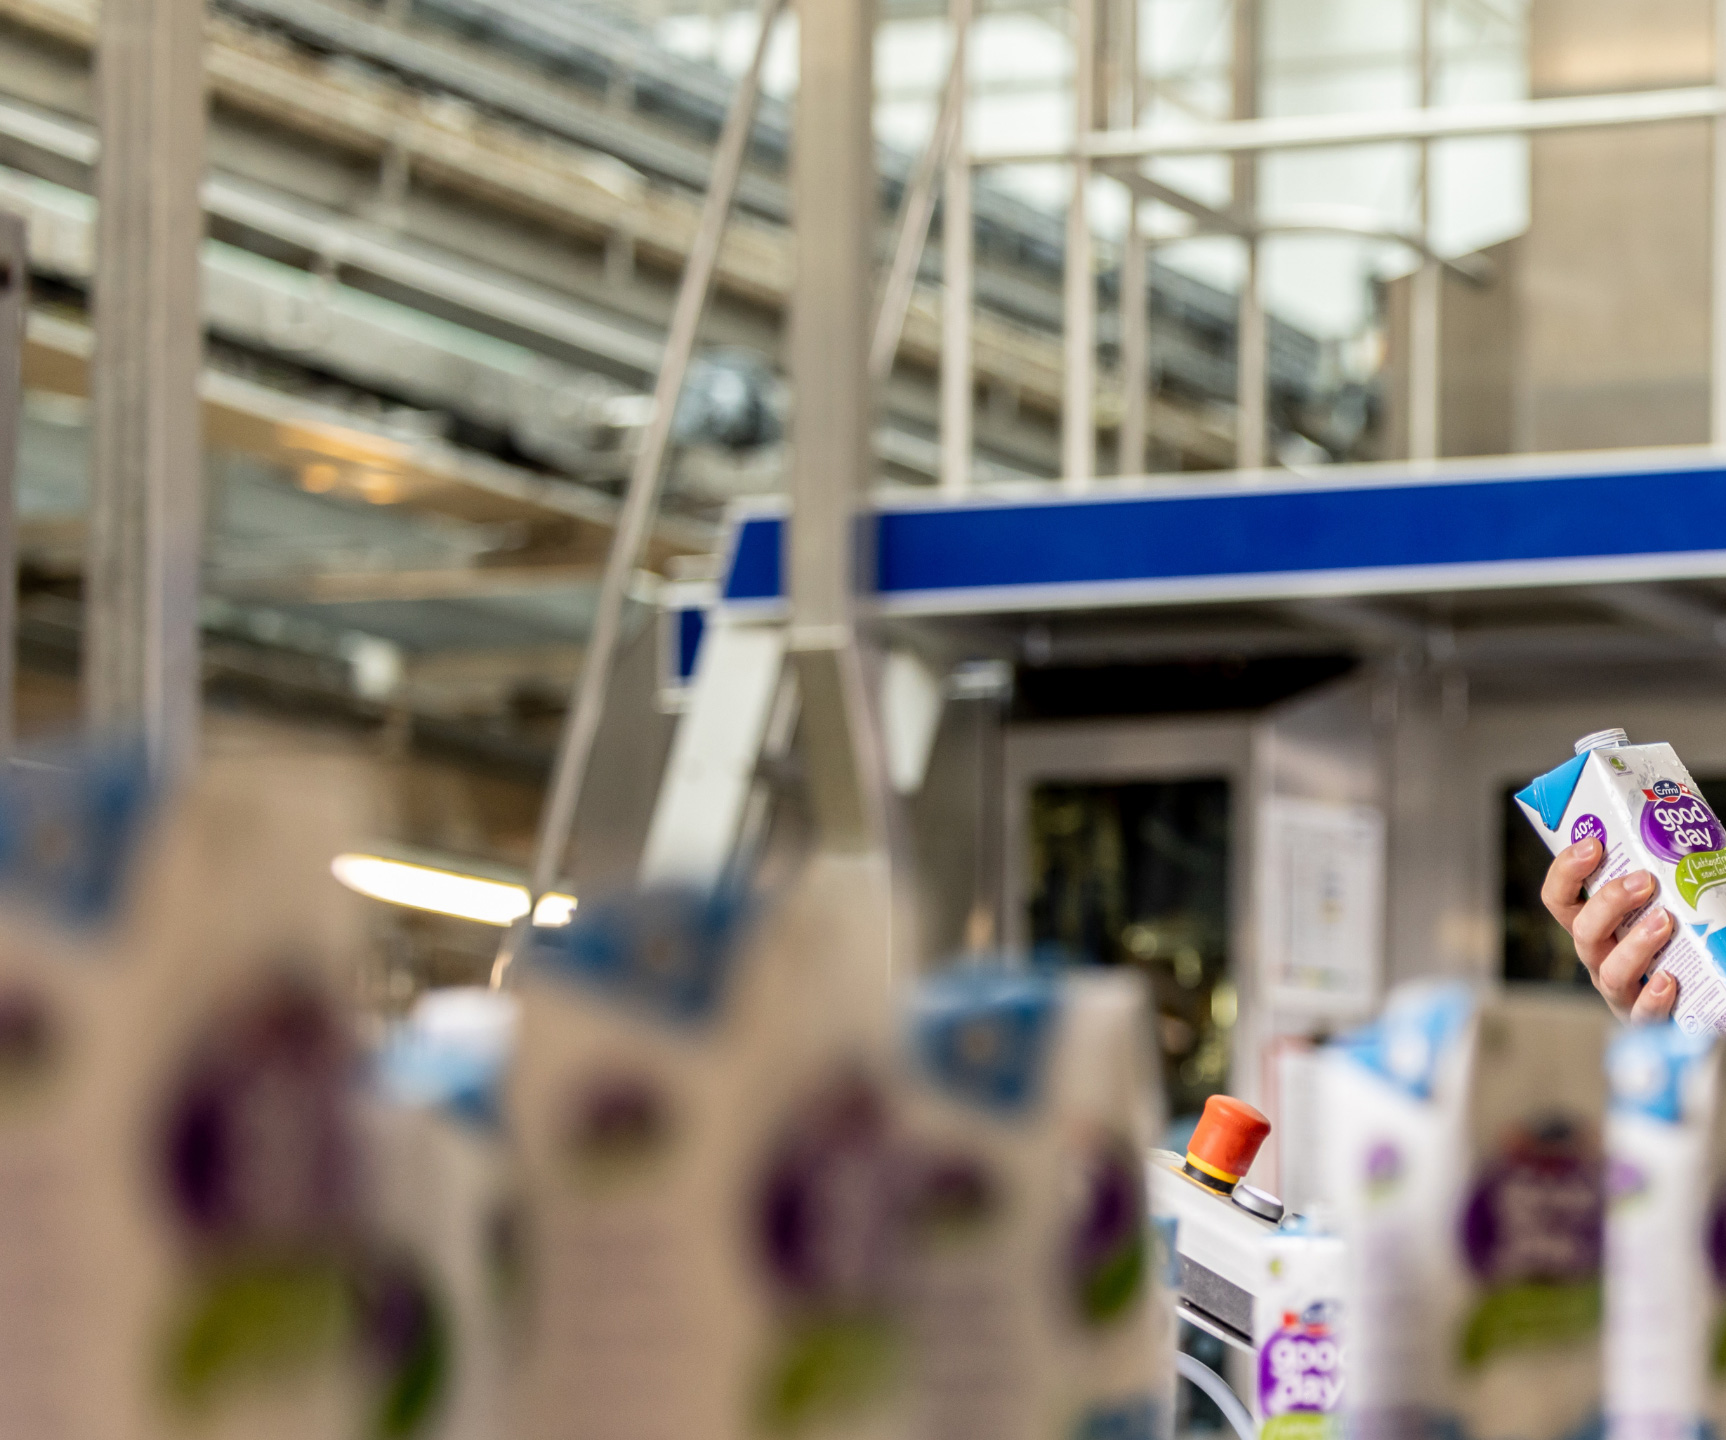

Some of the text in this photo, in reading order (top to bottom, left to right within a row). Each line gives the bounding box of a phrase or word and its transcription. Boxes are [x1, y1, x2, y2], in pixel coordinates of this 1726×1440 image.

[1654, 785, 1679, 796] Emmi
[1654, 801, 1708, 832] good
[1674, 825, 1713, 848] day
